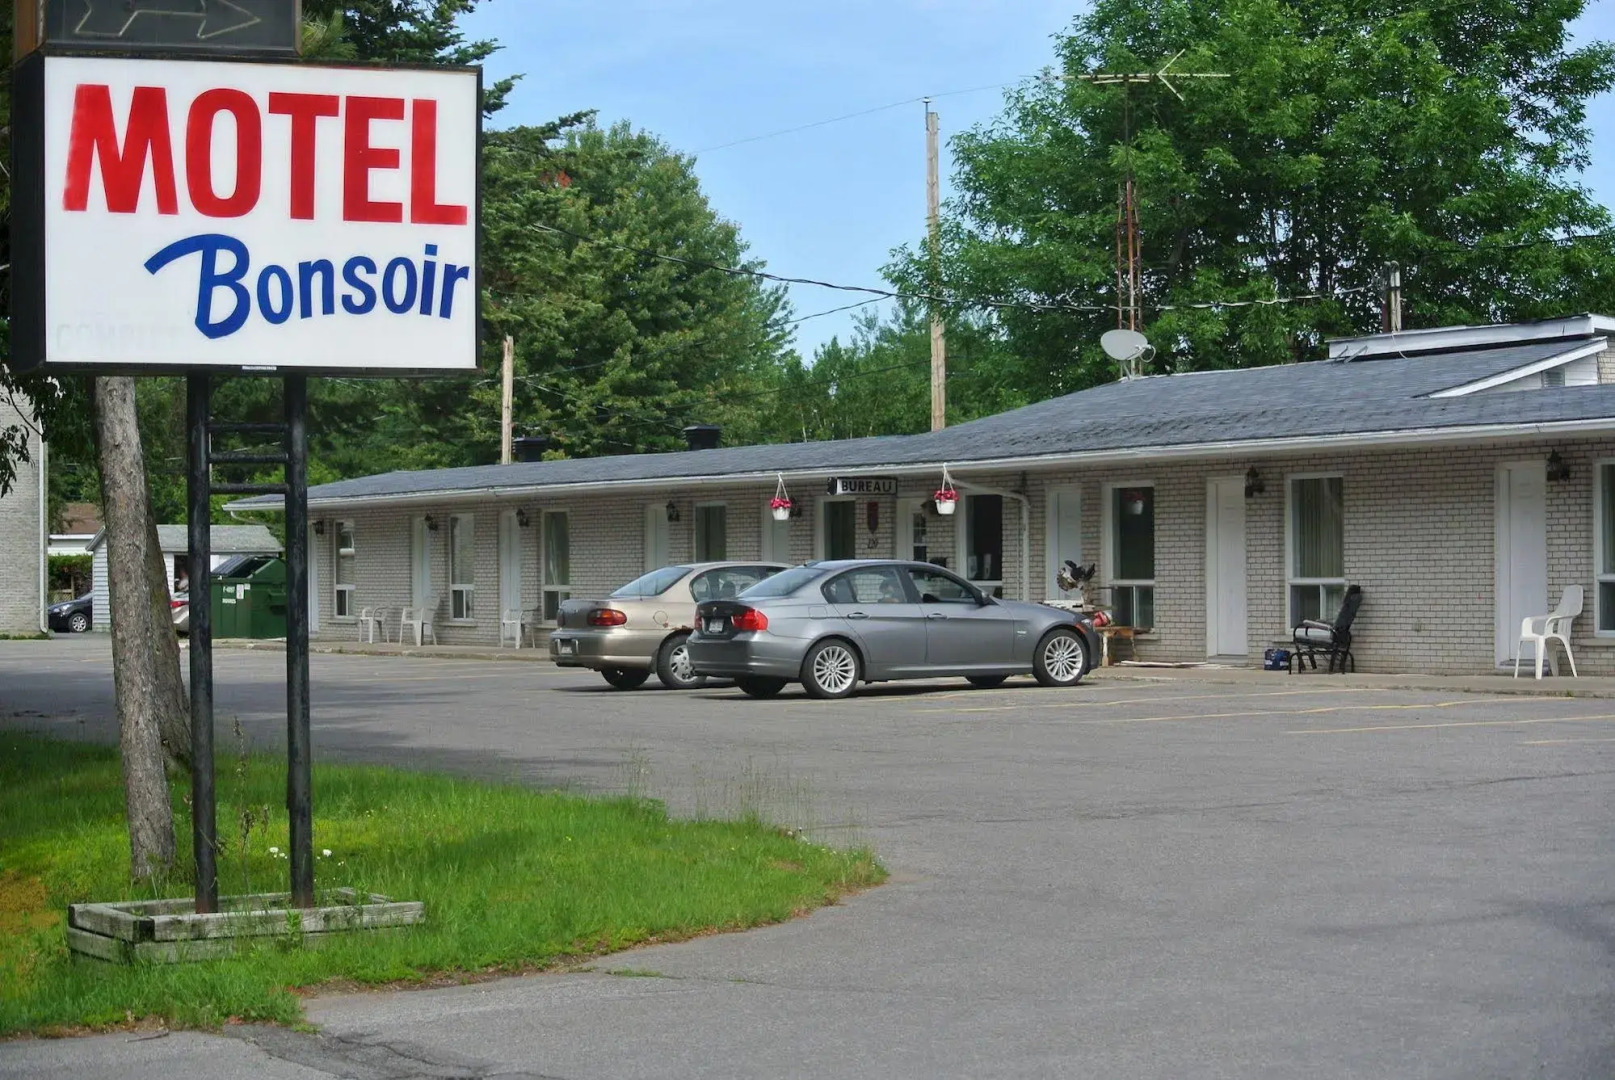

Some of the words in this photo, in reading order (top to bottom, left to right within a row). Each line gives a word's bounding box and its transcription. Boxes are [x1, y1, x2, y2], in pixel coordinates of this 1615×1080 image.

[63, 84, 468, 225] MOTEL
[144, 233, 470, 339] Bonsoir
[842, 480, 892, 492] BUREAU
